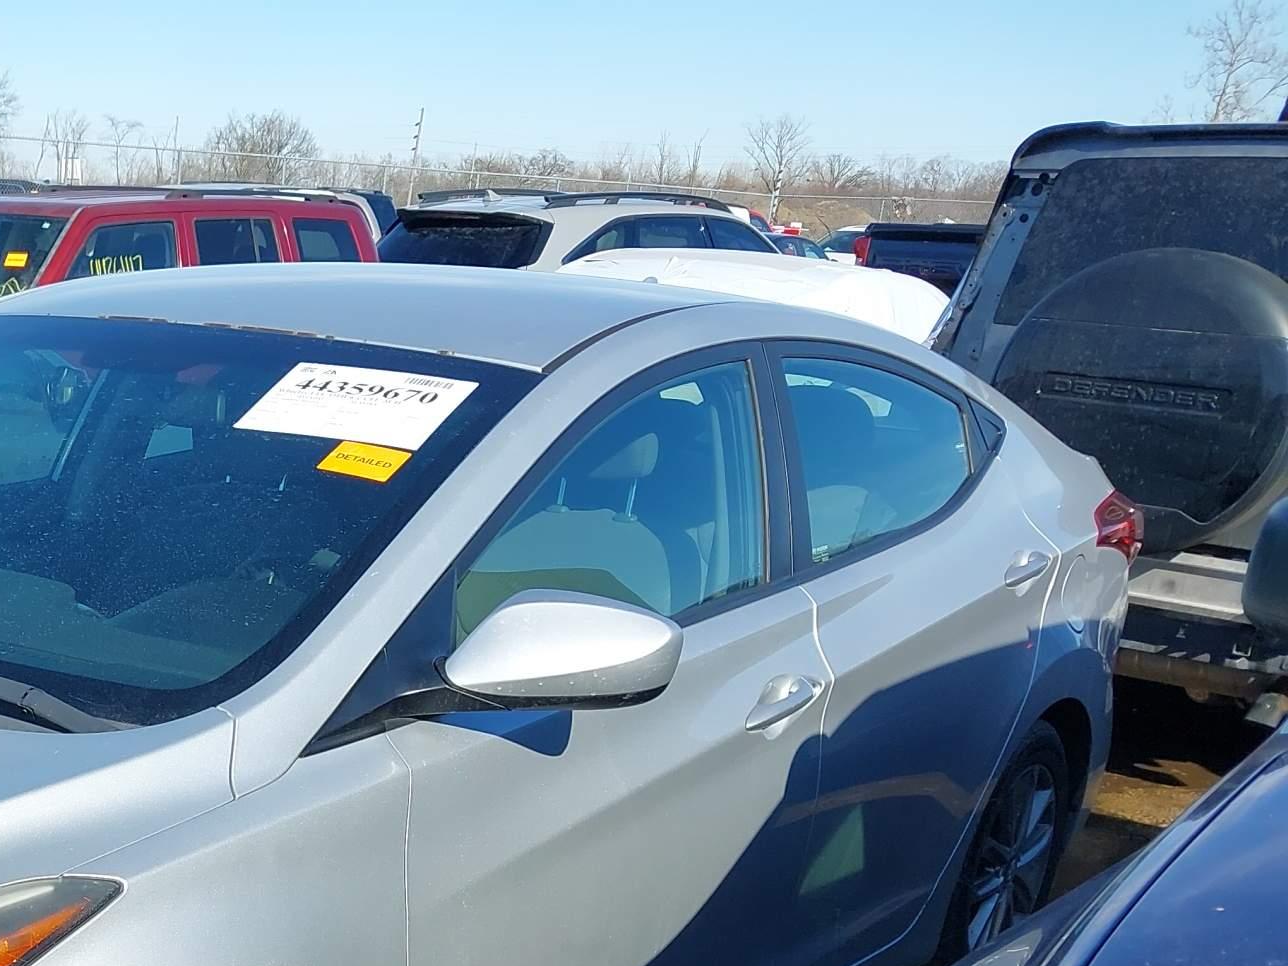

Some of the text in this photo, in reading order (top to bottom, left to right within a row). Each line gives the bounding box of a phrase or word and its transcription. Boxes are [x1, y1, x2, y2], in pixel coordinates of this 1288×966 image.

[295, 377, 439, 405] 44359670
[1053, 376, 1219, 409] DEFENDER
[335, 452, 393, 469] DETAILED
